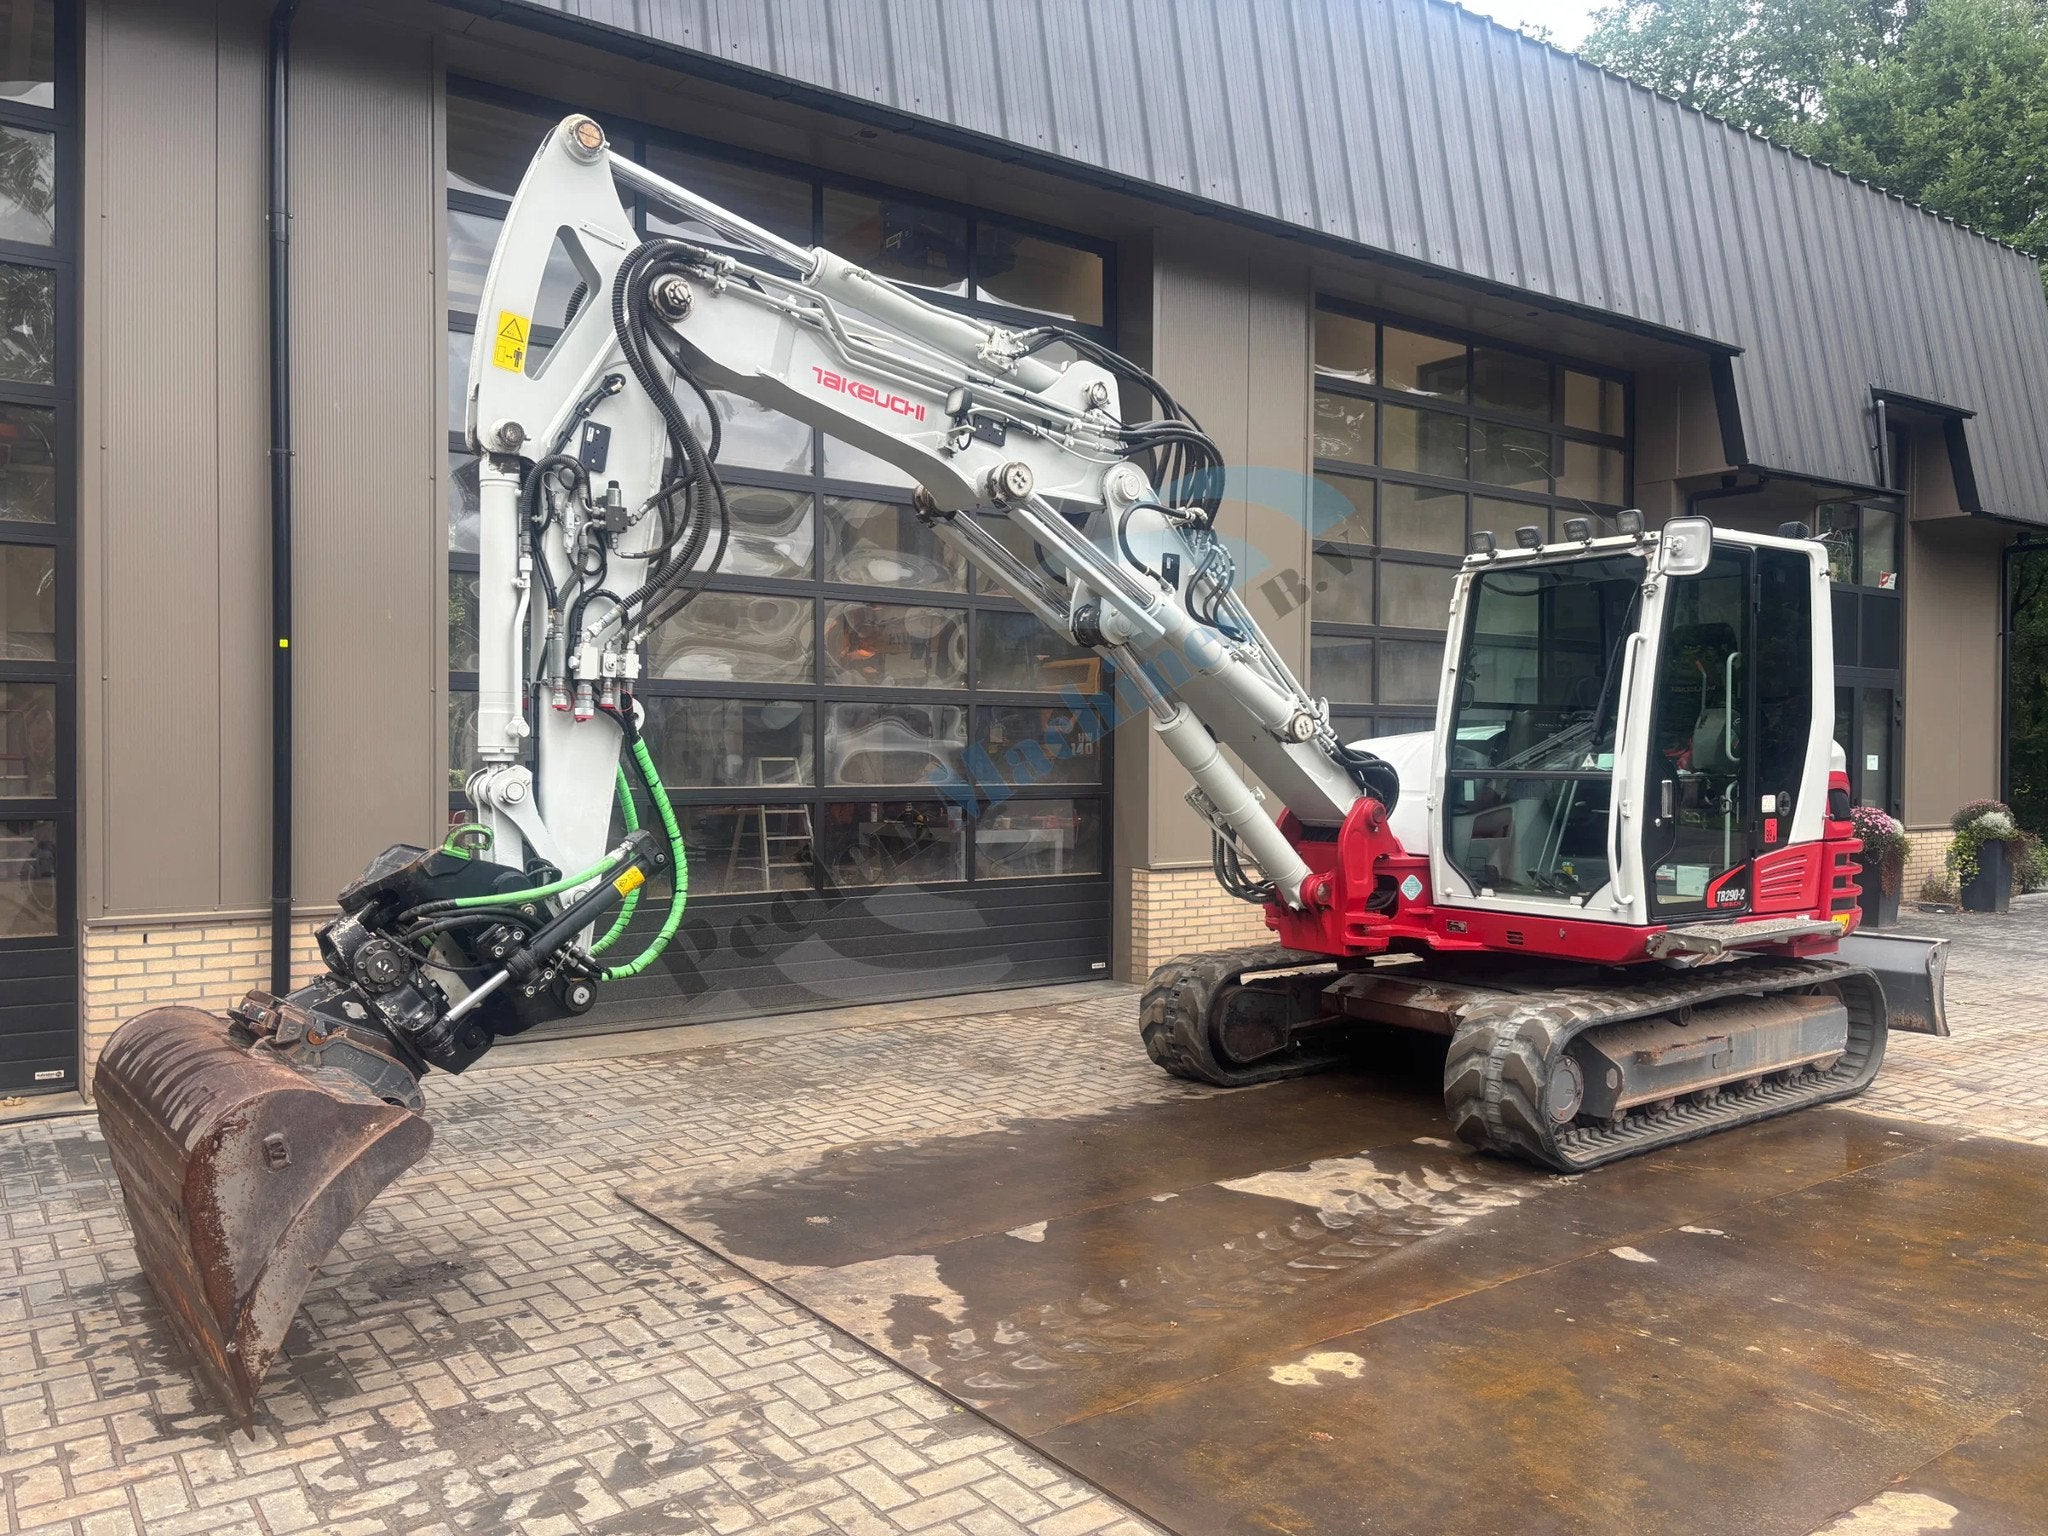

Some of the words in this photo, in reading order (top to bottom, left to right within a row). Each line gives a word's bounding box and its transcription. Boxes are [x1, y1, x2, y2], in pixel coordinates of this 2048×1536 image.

[812, 366, 925, 422] TAKEUCHI
[1070, 742, 1094, 756] 140
[1716, 888, 1746, 903] TB290-2
